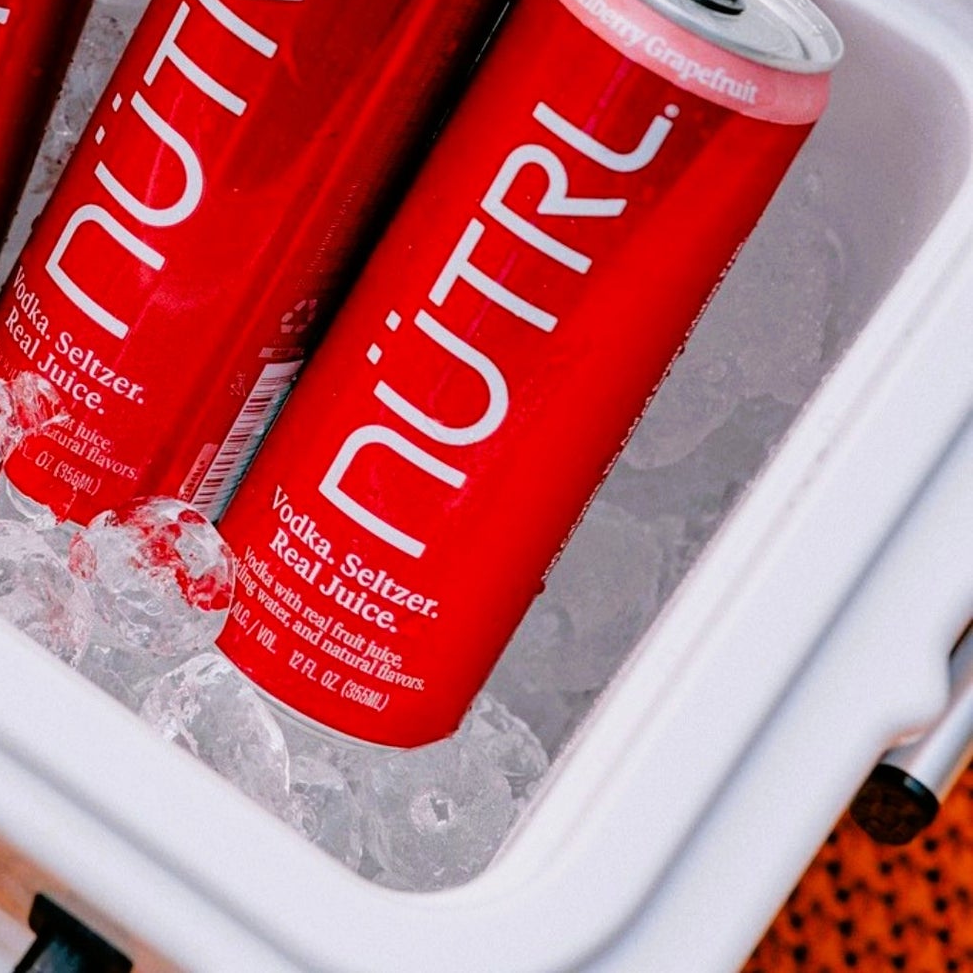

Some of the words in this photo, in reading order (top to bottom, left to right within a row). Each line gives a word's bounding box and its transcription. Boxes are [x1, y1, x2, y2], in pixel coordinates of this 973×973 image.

[644, 34, 759, 105] Grapefruit
[5, 306, 39, 361] Real
[37, 353, 105, 416] Juice.
[13, 265, 51, 342] Vodka.
[55, 331, 145, 406] Seltzer.
[53, 460, 102, 496] (355ML)
[73, 422, 112, 454] juice,
[85, 446, 139, 480] flavors.
[268, 527, 322, 586] Real
[319, 574, 399, 634] Juice.
[271, 485, 335, 565] Vodka.
[340, 553, 439, 620] Seltzer.
[244, 545, 275, 588] Vodka
[274, 581, 303, 613] with
[302, 606, 334, 632] real
[330, 621, 367, 653] fruit
[364, 640, 403, 669] juice,
[257, 587, 292, 628] water,
[291, 619, 324, 646] and
[321, 638, 379, 677] natural
[375, 660, 425, 692] flavors.
[288, 649, 304, 669] 12
[300, 659, 318, 682] FL.
[320, 669, 341, 692] OZ.
[340, 677, 390, 712] (355ML)
